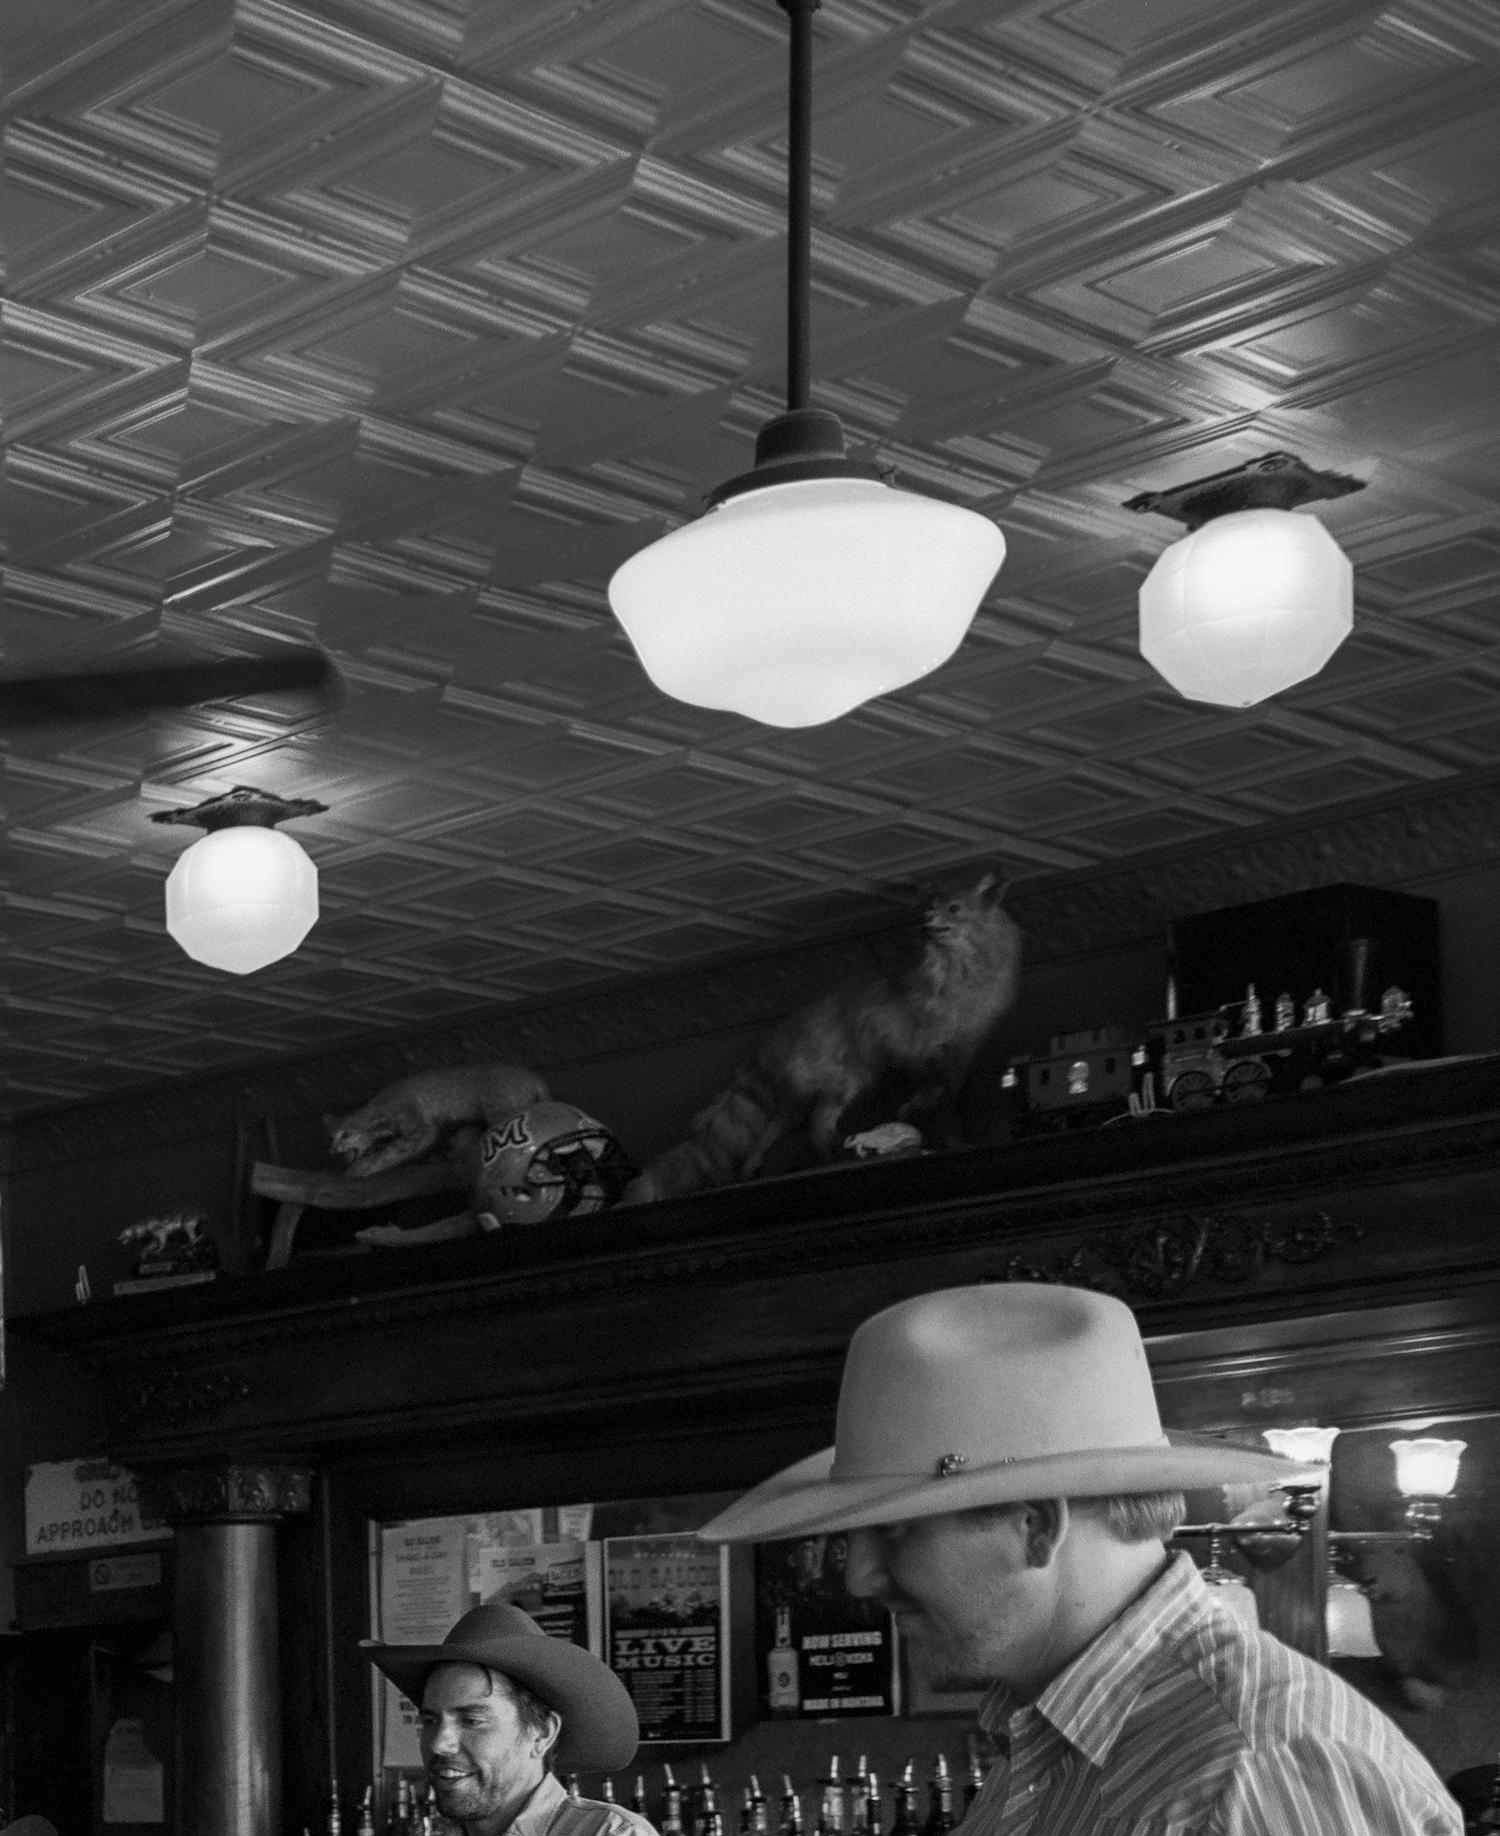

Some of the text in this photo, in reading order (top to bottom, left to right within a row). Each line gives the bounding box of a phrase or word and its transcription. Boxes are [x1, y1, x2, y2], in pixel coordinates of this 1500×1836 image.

[480, 1112, 532, 1168] M
[80, 1487, 138, 1510] DO NO
[36, 1513, 135, 1544] APPROACH
[614, 1635, 716, 1655] LIVE
[831, 1630, 882, 1648] SERVING
[614, 1653, 716, 1670] MUSIC
